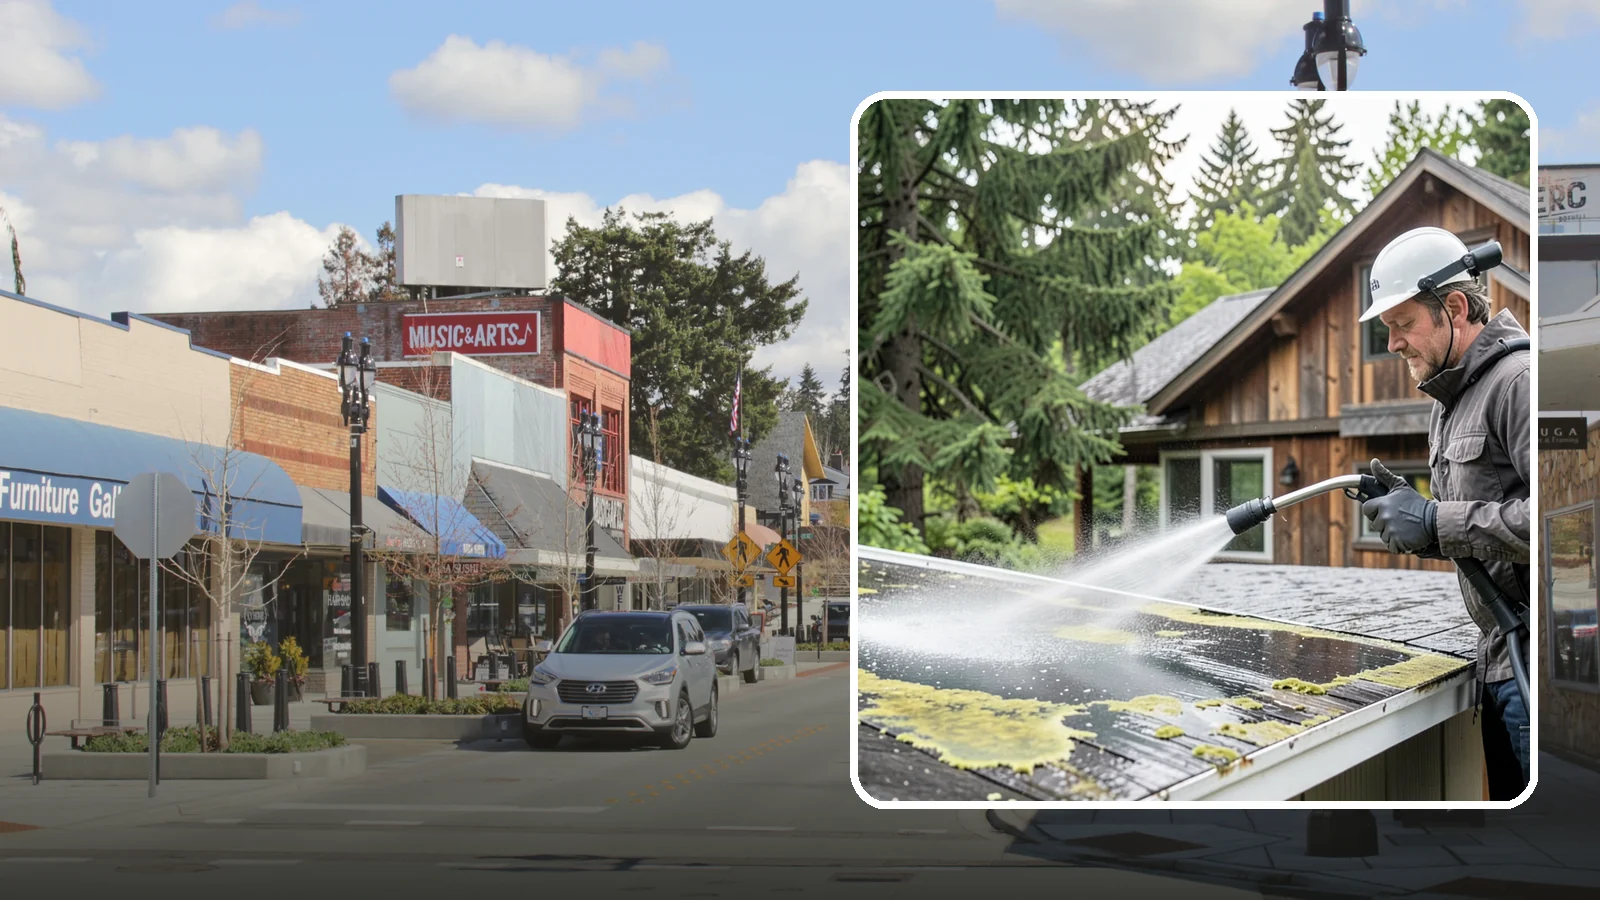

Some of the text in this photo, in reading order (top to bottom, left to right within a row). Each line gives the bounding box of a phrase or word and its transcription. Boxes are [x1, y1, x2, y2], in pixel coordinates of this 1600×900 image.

[408, 323, 519, 349] MUSIC&ARTS
[0, 471, 79, 515] Furniture
[453, 563, 480, 574] SUSHI
